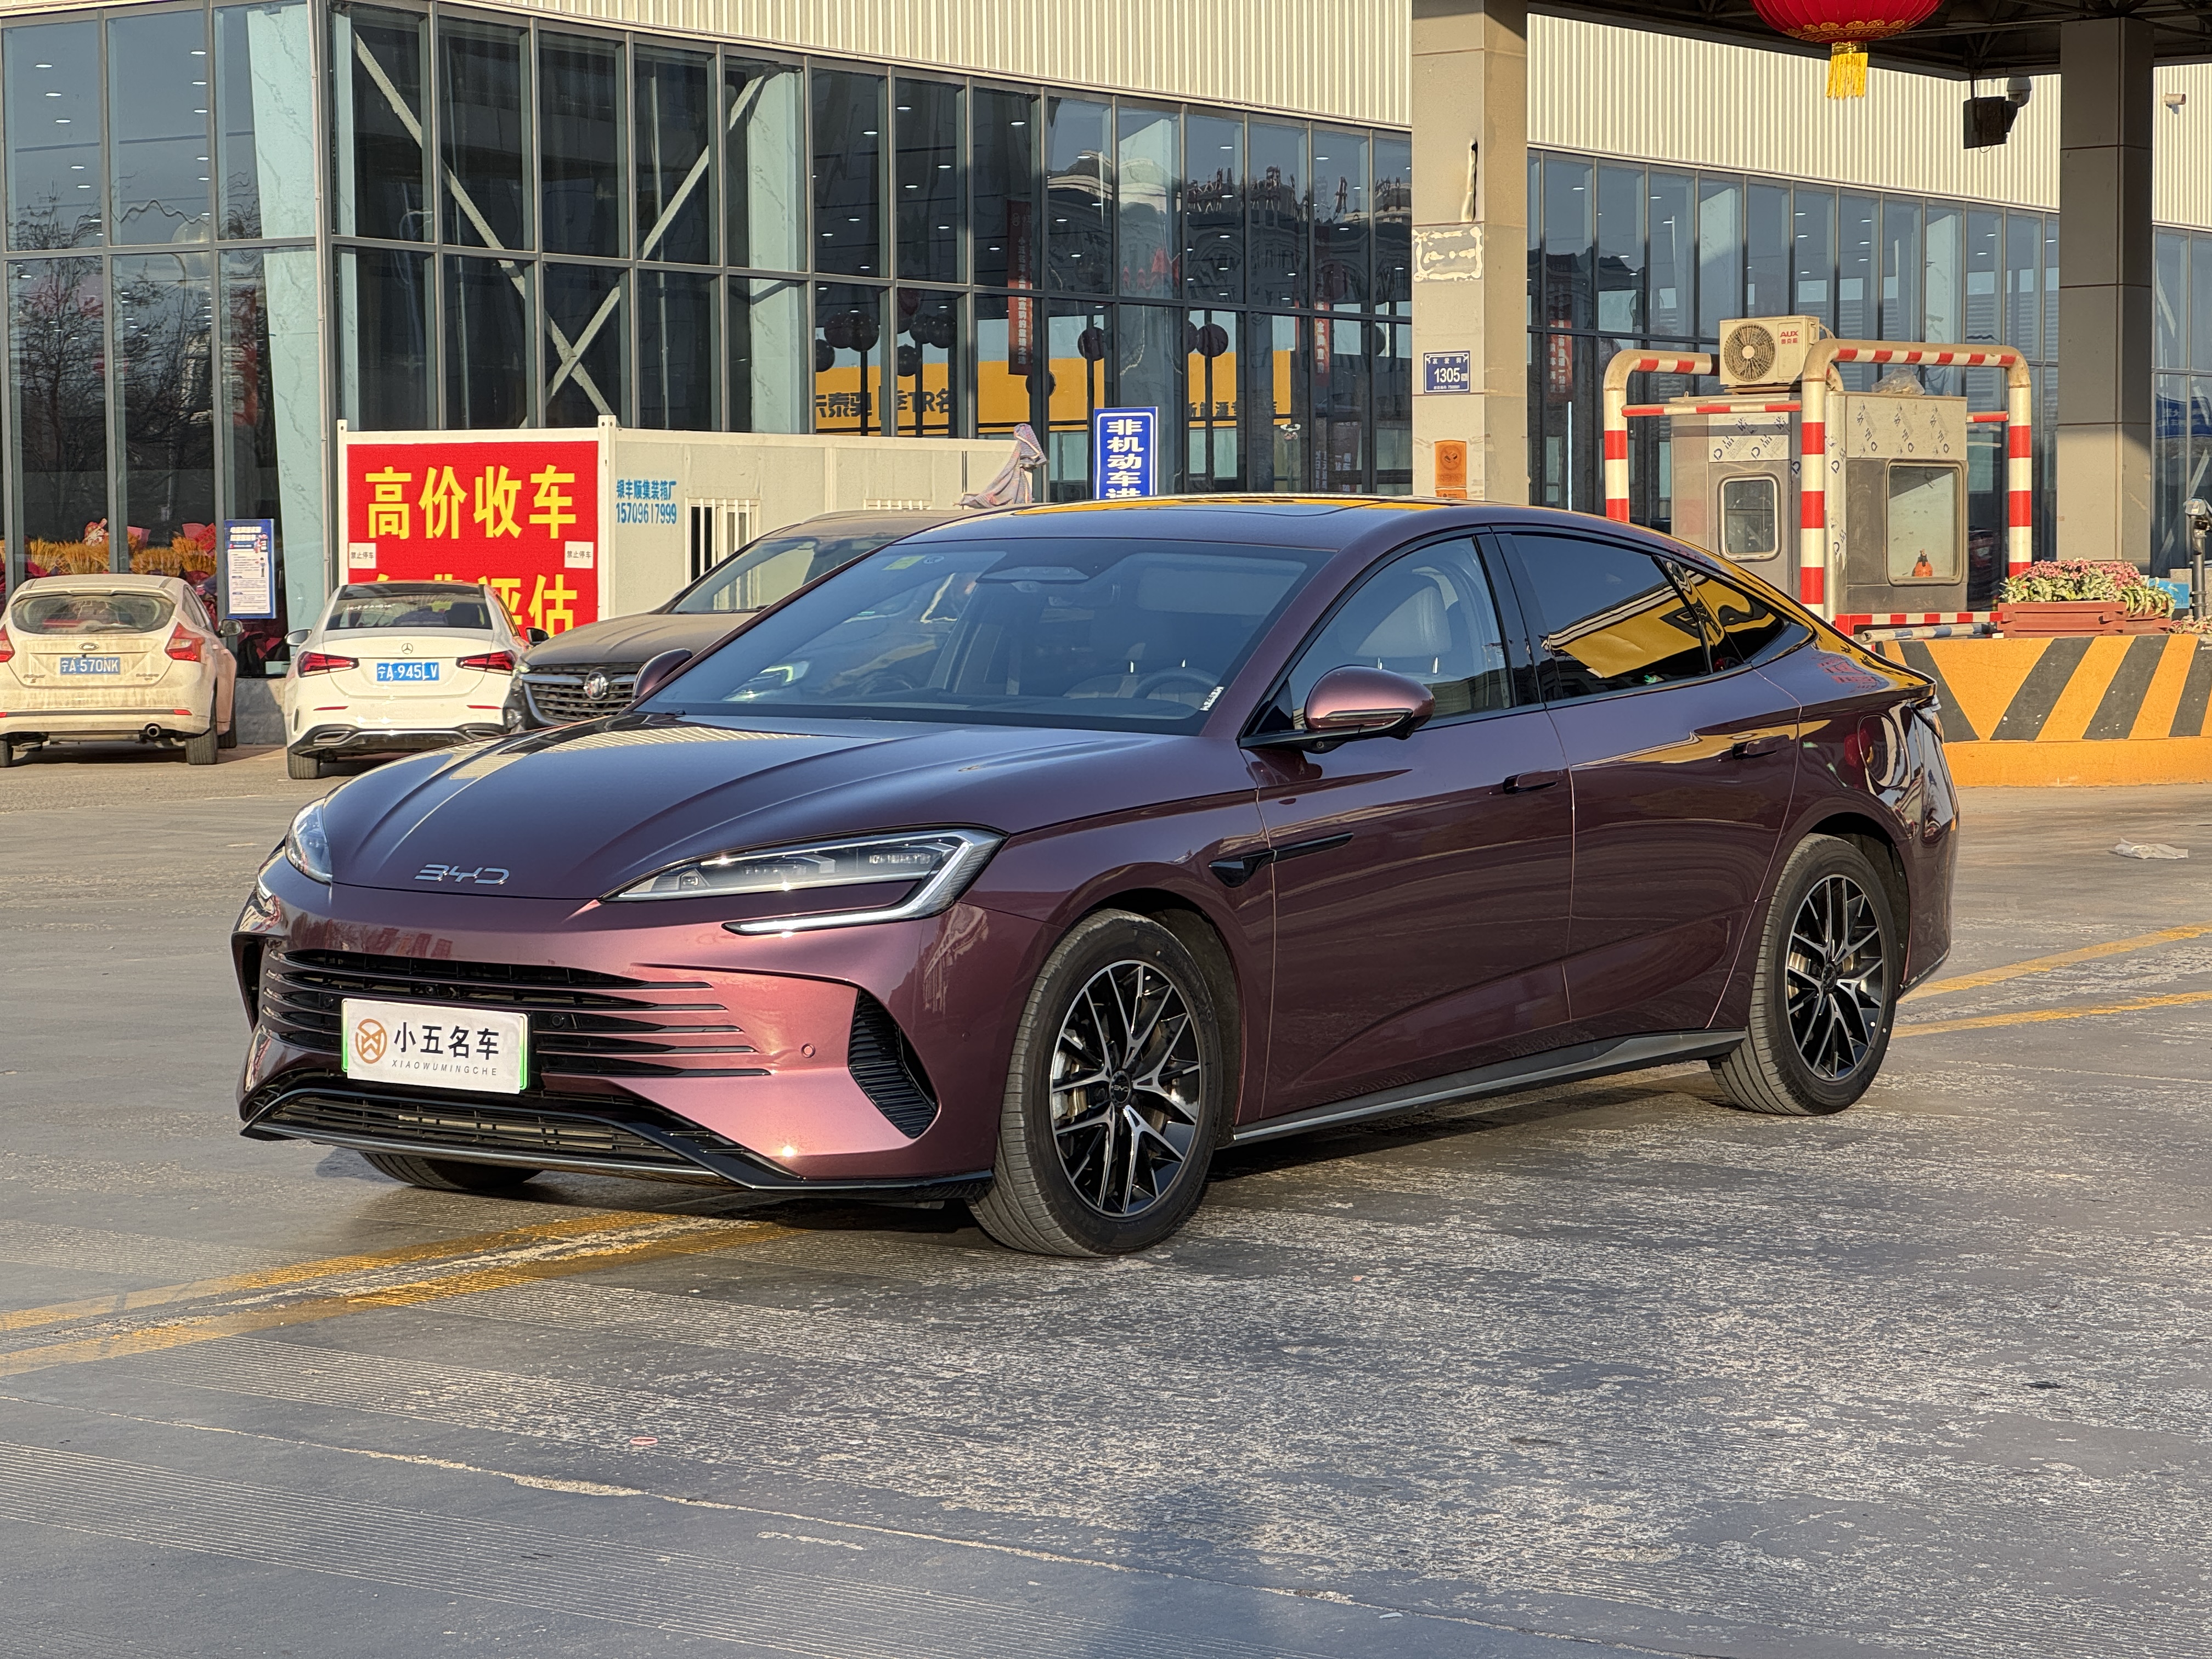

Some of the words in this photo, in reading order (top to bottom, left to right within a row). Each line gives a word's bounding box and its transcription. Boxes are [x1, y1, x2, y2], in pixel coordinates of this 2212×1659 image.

[1434, 368, 1460, 383] 1305
[365, 464, 576, 540] 高价收车
[616, 502, 677, 524] 15709617999
[351, 551, 374, 560] 禁止停车
[567, 550, 592, 559] 禁止停车
[414, 864, 510, 885] BYD
[394, 1022, 500, 1060] 小五名车
[392, 1059, 498, 1076] XIAOWUMINGCHE
